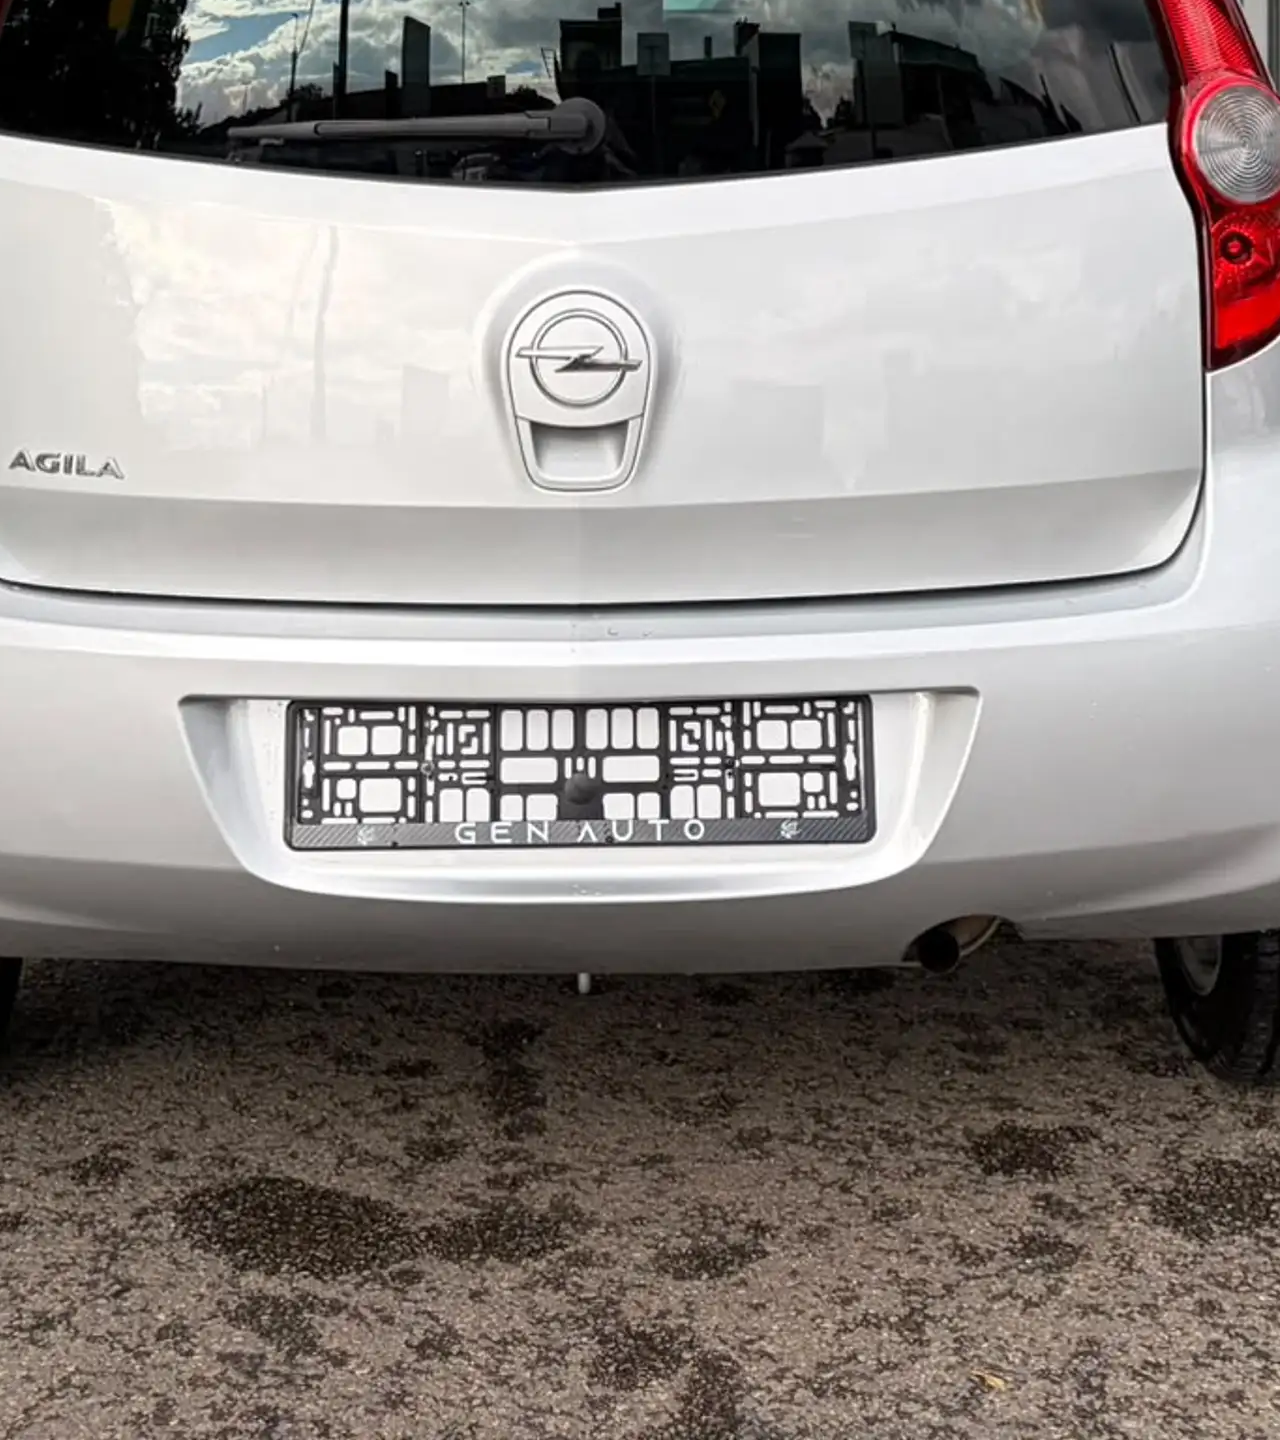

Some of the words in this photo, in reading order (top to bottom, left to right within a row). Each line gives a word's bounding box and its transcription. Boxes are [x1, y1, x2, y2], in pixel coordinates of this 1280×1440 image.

[8, 447, 126, 480] AGILA
[454, 822, 550, 845] GEN
[575, 817, 706, 844] AUTO
